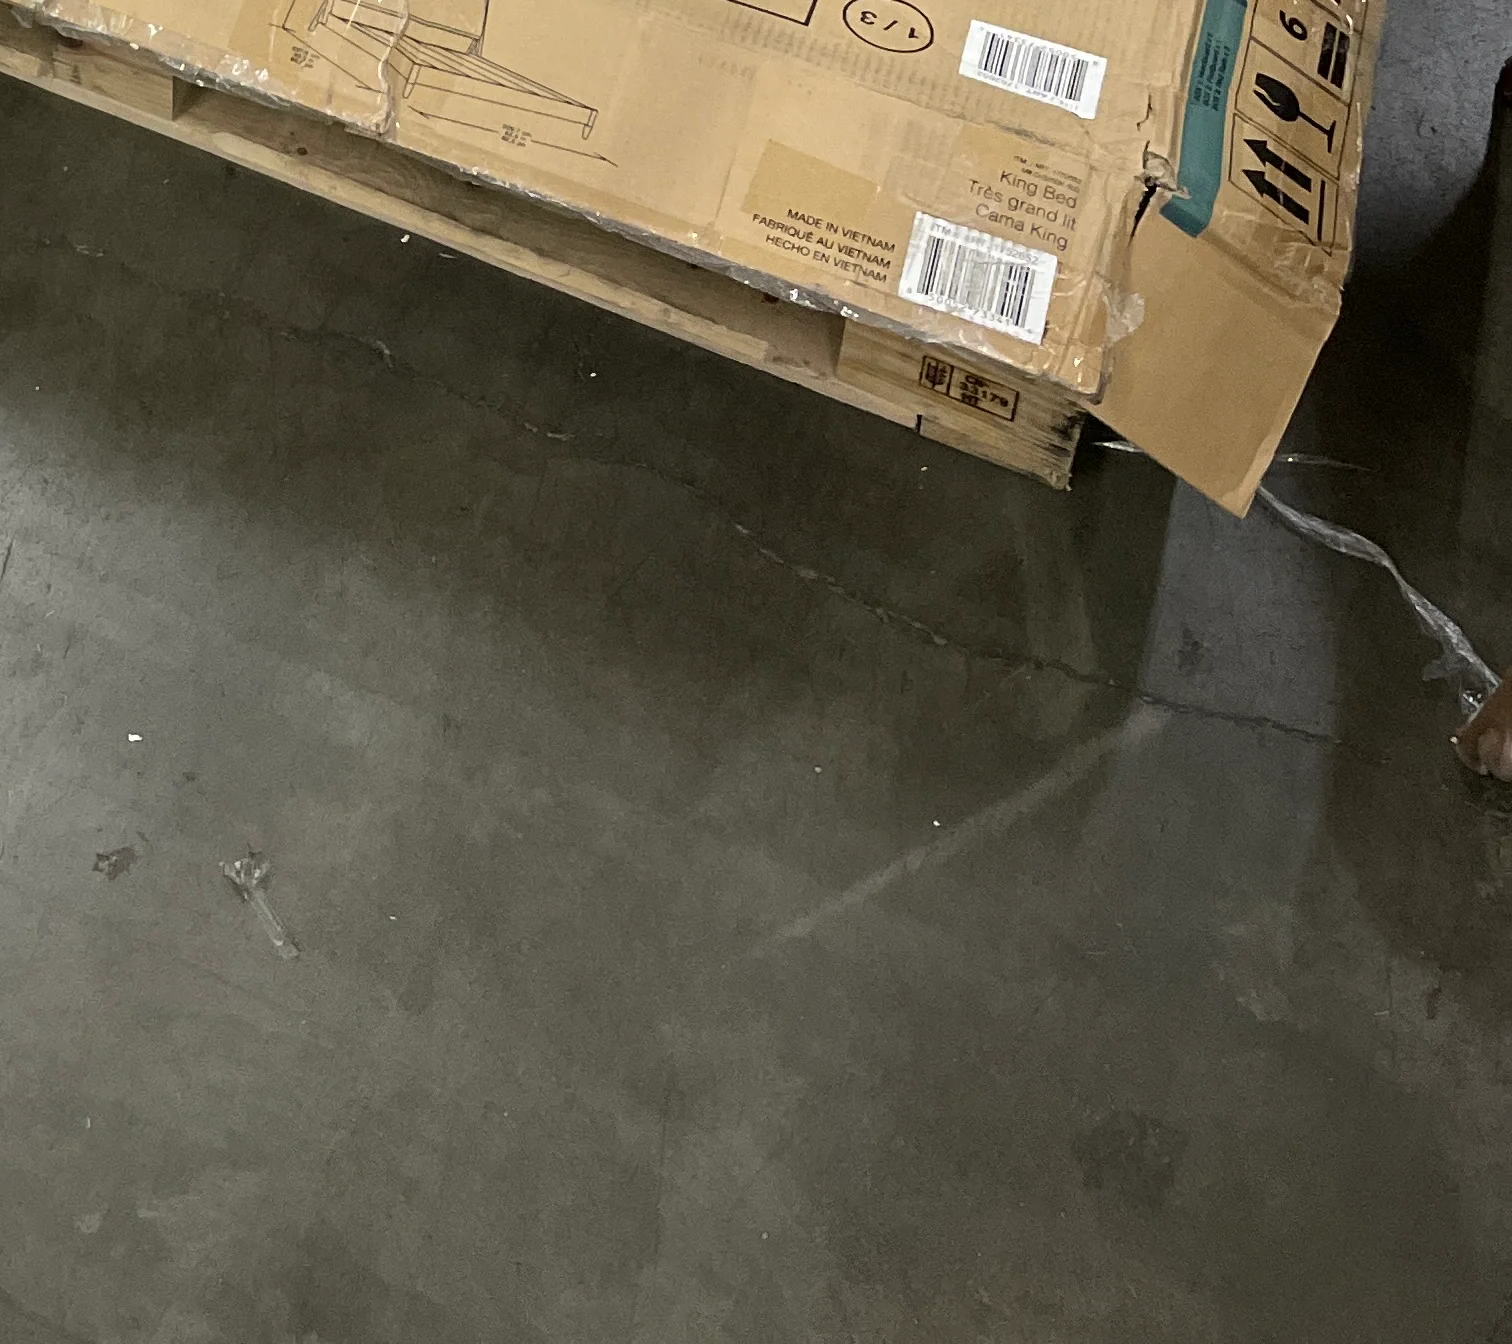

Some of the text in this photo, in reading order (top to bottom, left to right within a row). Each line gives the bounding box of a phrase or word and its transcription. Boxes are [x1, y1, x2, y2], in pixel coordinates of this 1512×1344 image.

[967, 177, 1077, 232] Très grand lit
[999, 169, 1078, 209] King Bed
[786, 207, 895, 253] MADE IN VIETNAM
[974, 202, 1068, 252] Cama King
[764, 233, 887, 283] HECHO EN VIETNAM
[814, 235, 835, 250] AU
[836, 242, 891, 269] VIETNAM
